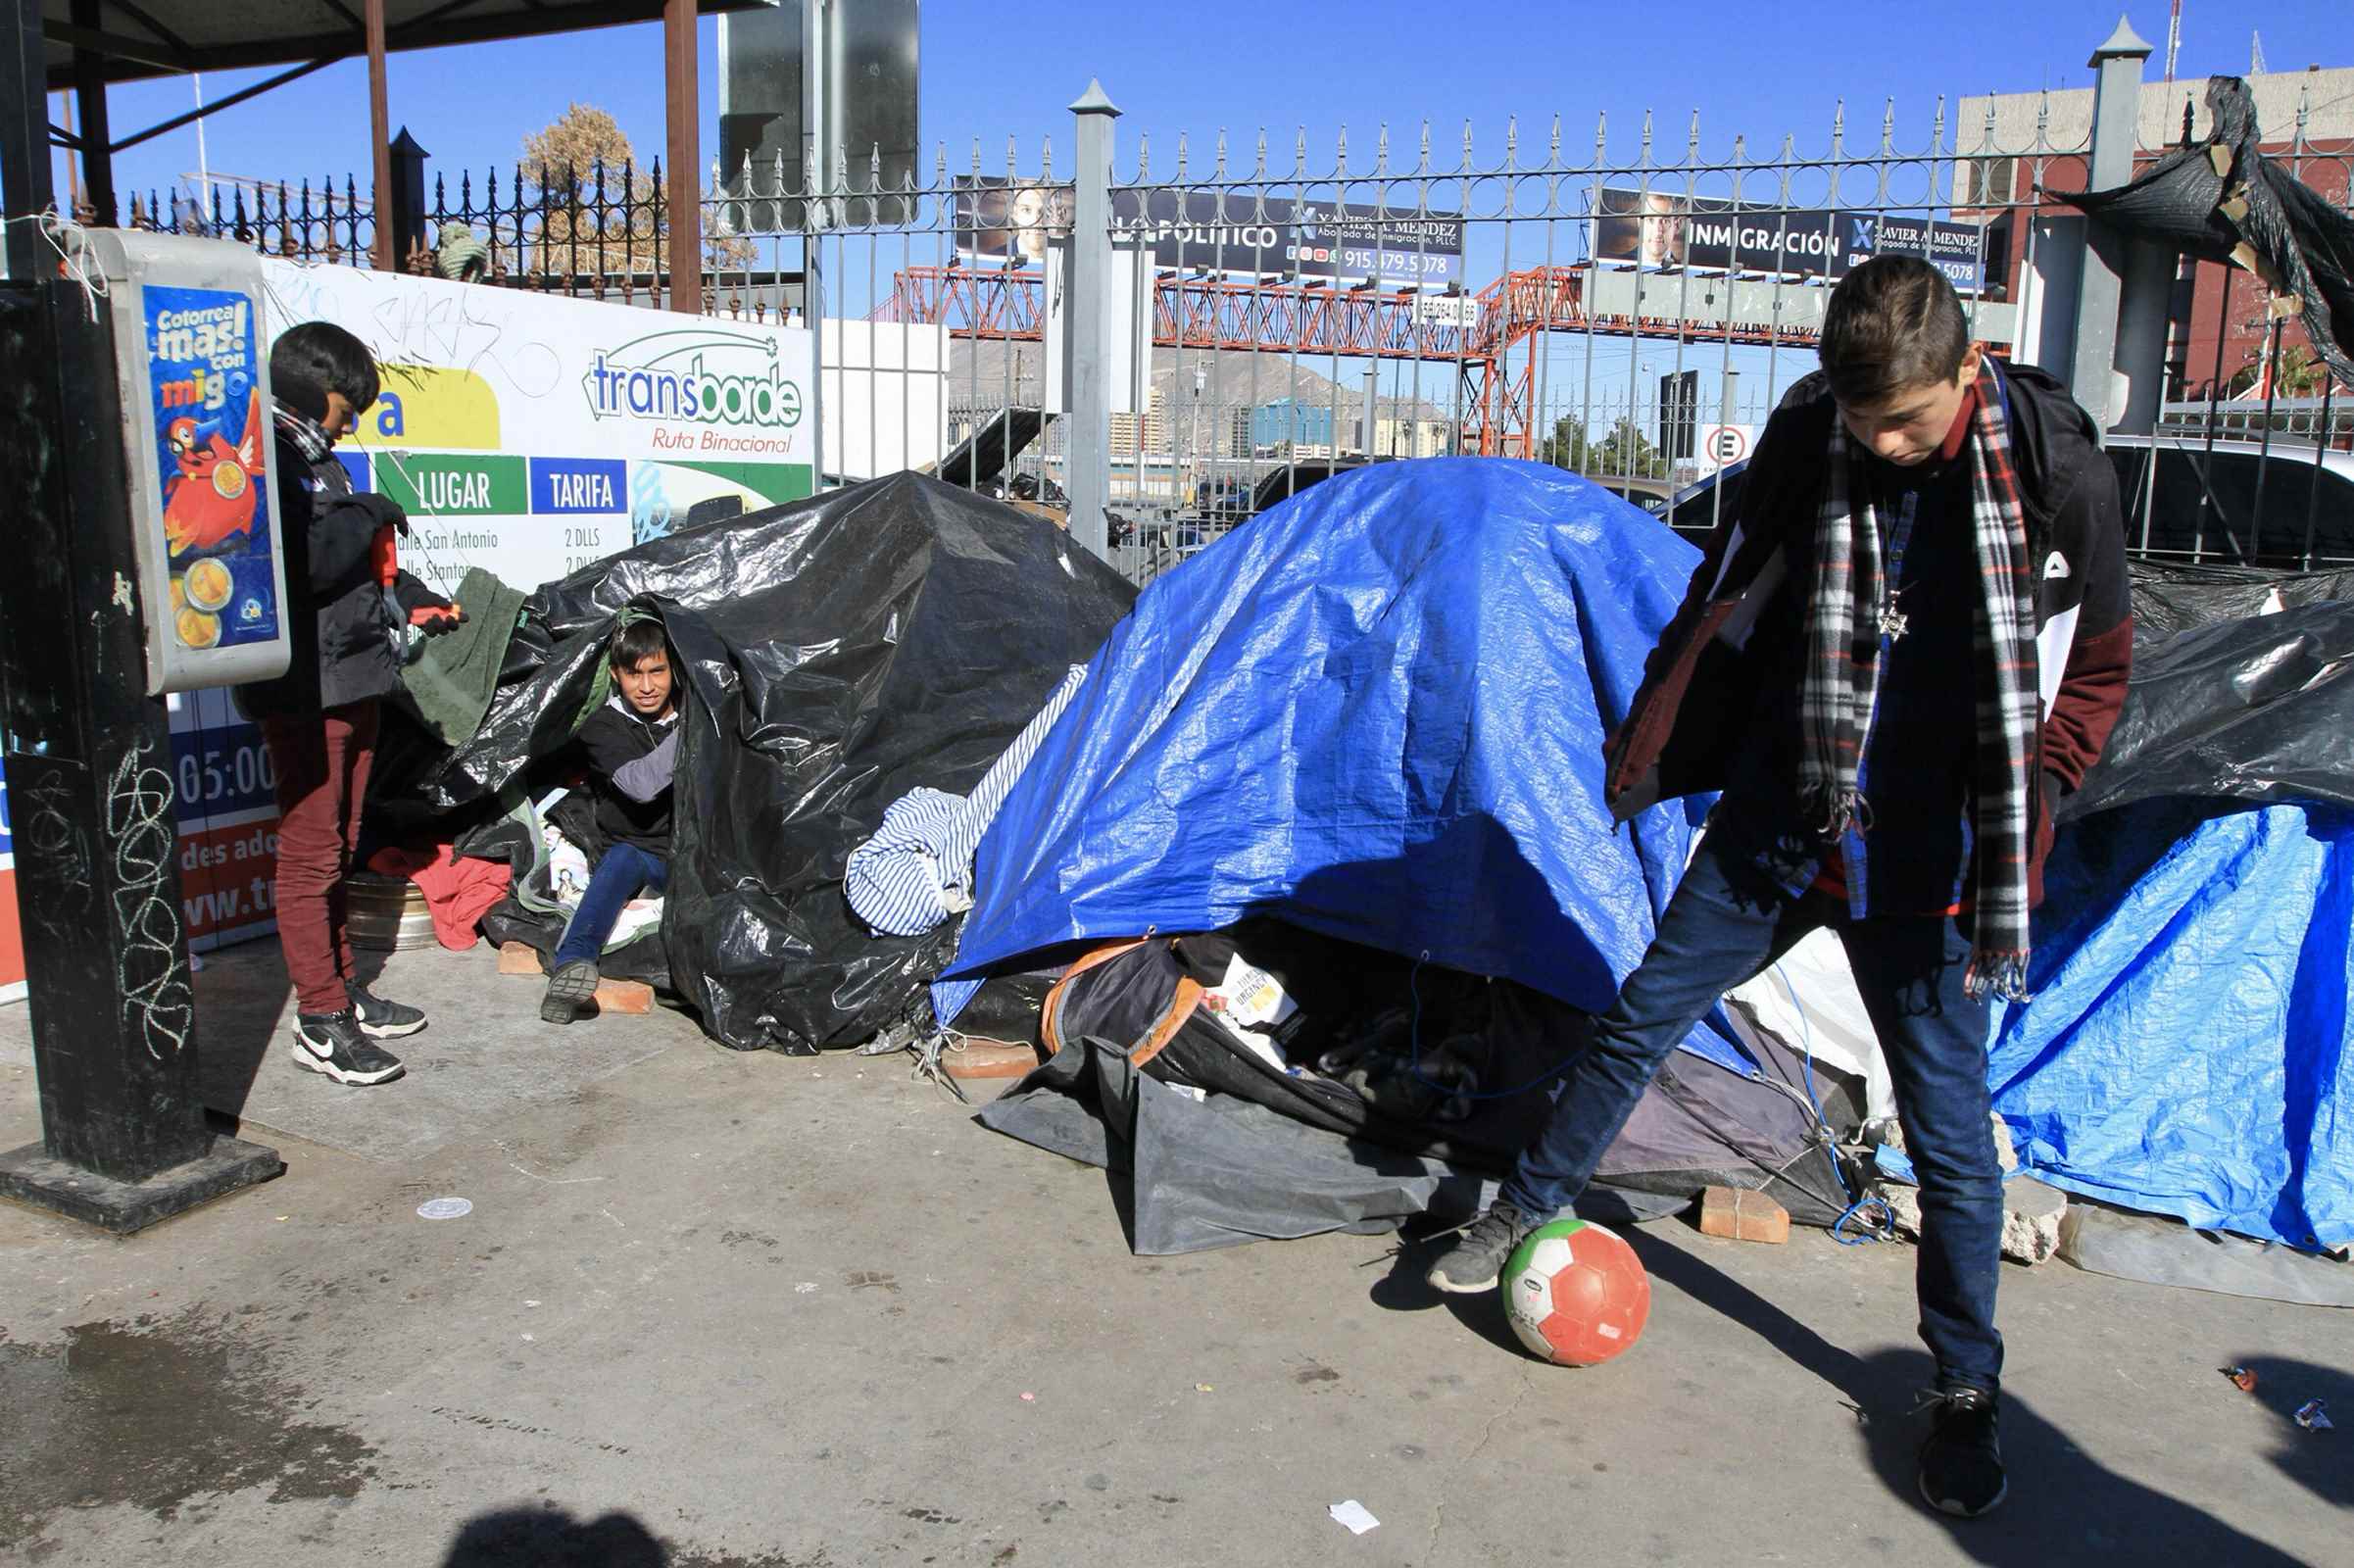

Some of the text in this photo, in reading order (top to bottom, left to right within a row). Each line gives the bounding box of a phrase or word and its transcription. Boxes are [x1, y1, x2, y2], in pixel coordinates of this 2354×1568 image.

[1158, 218, 1278, 249] POLÍTICO
[1318, 227, 1362, 240] Aboado
[1688, 221, 1839, 258] INMIGRACIÓN
[158, 305, 234, 331] Cotorrea
[211, 352, 246, 371] con
[590, 348, 803, 428] transborde
[652, 427, 793, 454] Ruta Binacional
[1716, 434, 1736, 458] E
[417, 470, 493, 510] LUGAR
[550, 472, 614, 509] TARIFA
[397, 528, 499, 552] alle San Antonio
[564, 527, 601, 548] 2 DLLS
[565, 556, 572, 576] 2
[178, 743, 277, 805] 05:00
